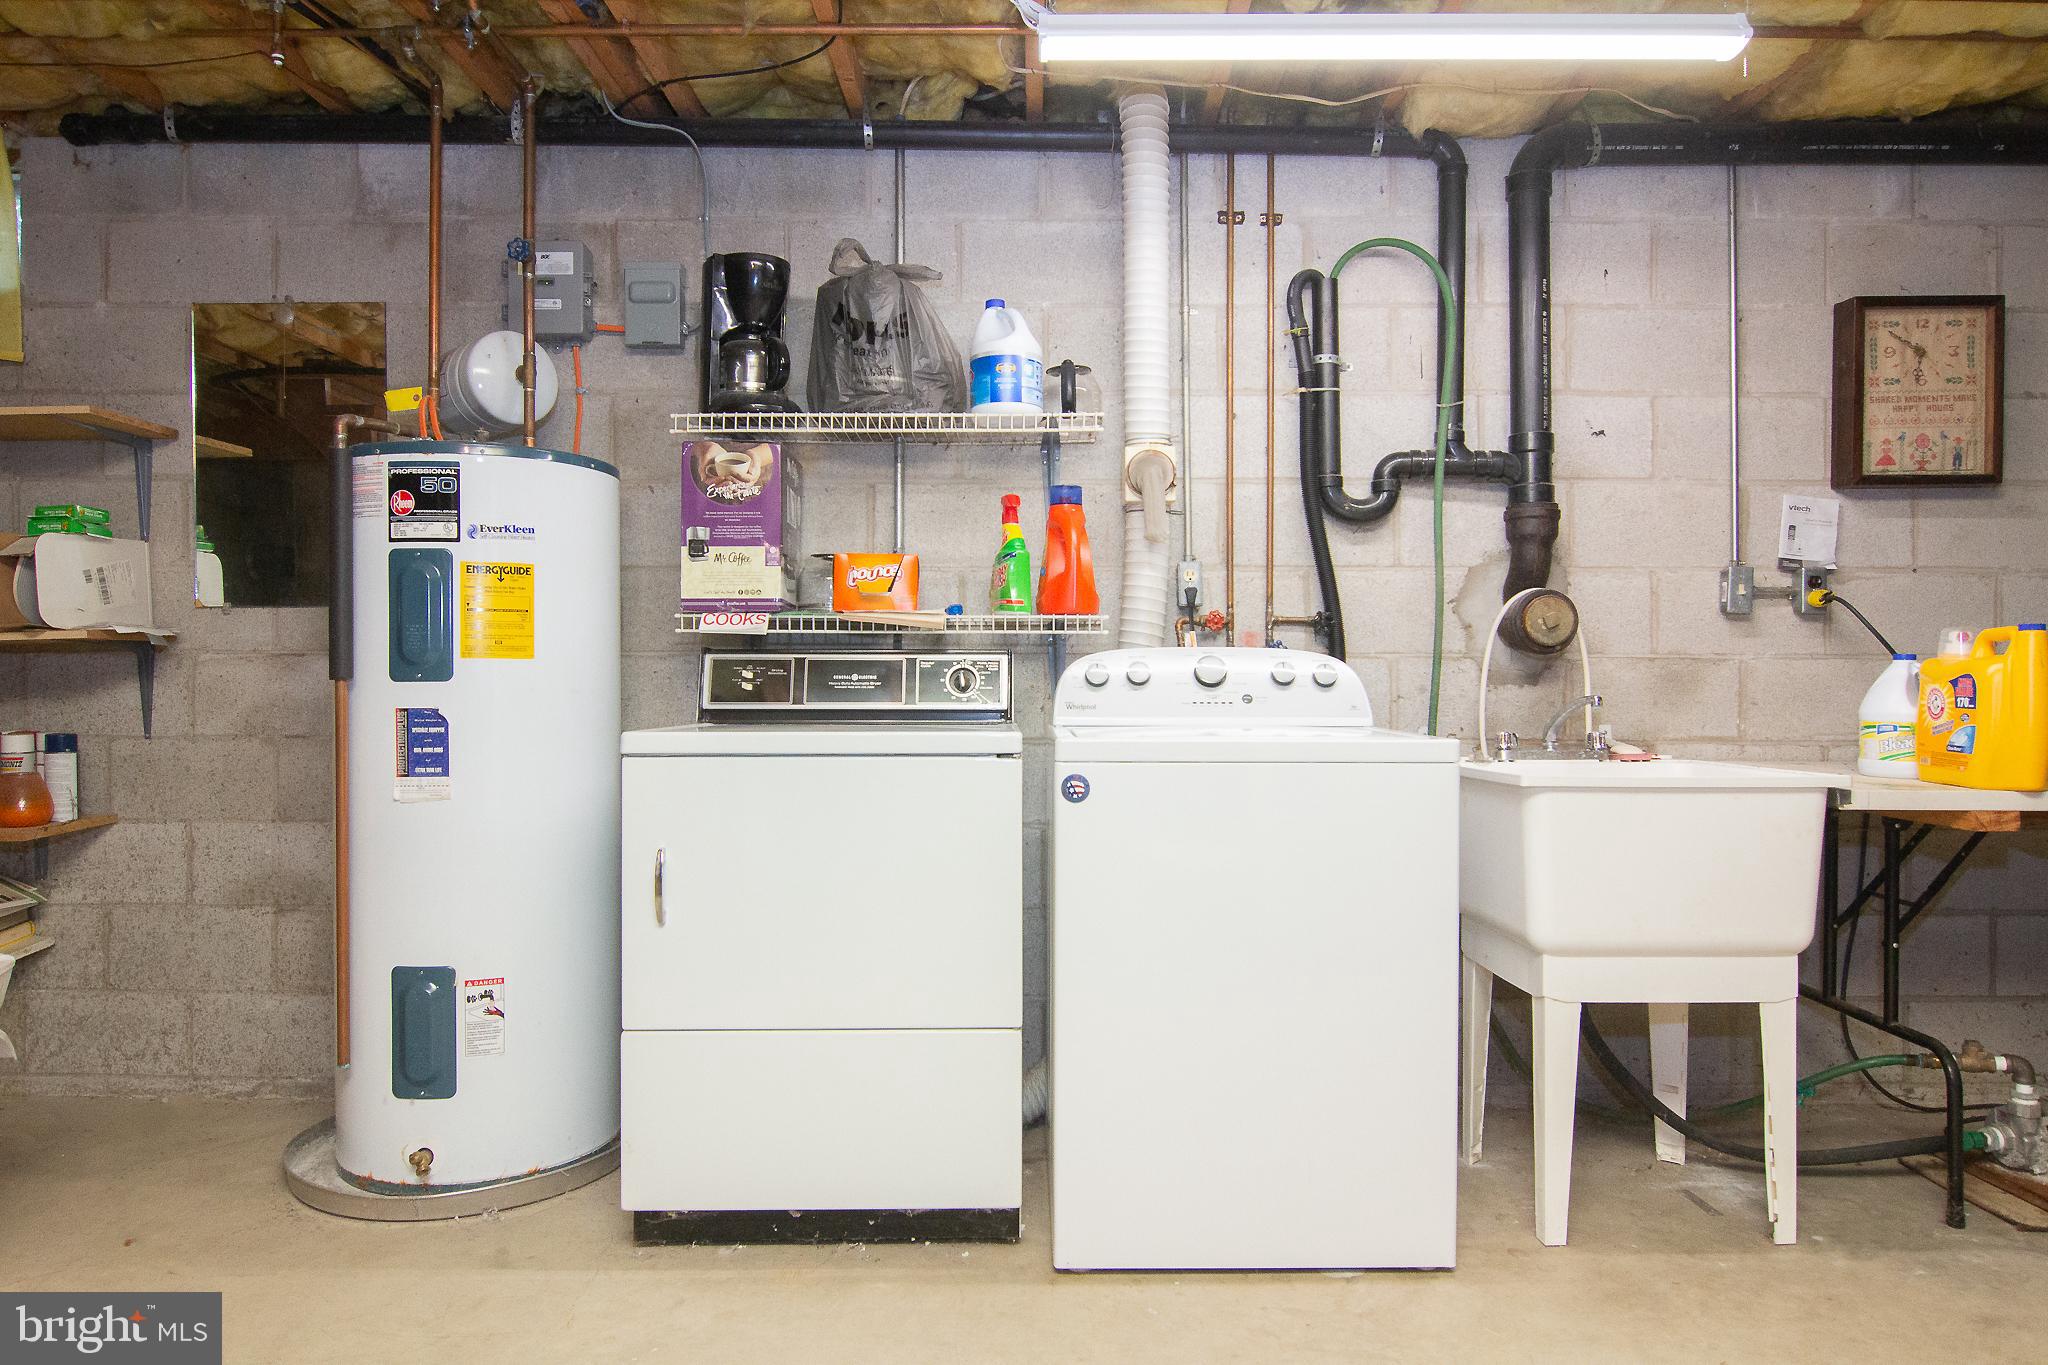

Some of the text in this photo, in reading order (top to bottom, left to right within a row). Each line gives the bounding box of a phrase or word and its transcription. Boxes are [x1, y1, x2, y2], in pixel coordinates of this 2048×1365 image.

[1916, 318, 1930, 329] 12
[1883, 346, 1897, 359] 9
[1948, 345, 1960, 357] 3
[1904, 395, 1950, 403] MOMENTS
[1953, 394, 1977, 402] MAKE
[1926, 404, 1954, 412] HOURS
[420, 476, 457, 494] 50
[479, 524, 535, 534] EverKleen
[728, 552, 753, 567] Coffee
[703, 612, 767, 626] COOKS
[1065, 703, 1097, 711] Whirlpool
[474, 978, 503, 986] DANGER
